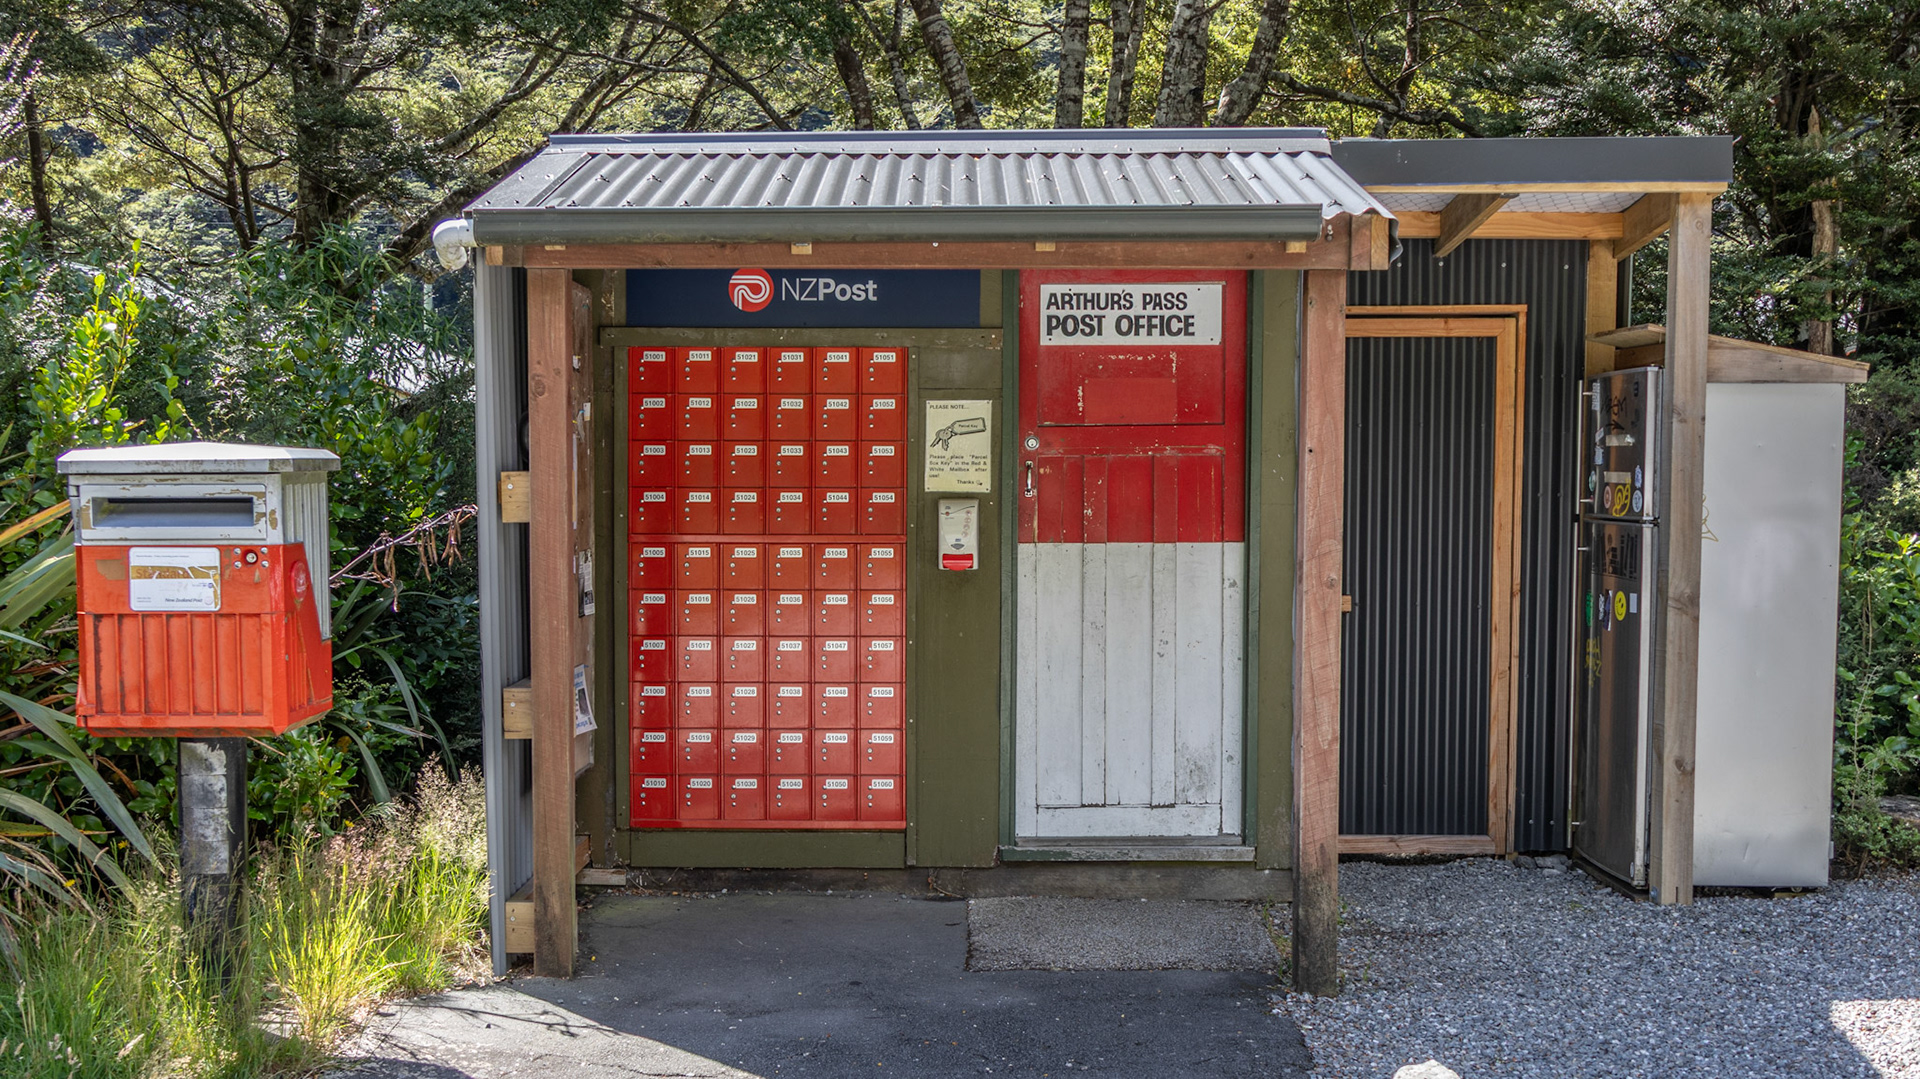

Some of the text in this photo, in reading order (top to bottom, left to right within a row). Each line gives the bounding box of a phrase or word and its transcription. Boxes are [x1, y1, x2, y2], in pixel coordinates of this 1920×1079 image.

[782, 278, 877, 301] NZPost
[1046, 289, 1188, 311] ARTHUR'S PASS
[1046, 314, 1195, 337] POST OFFICE
